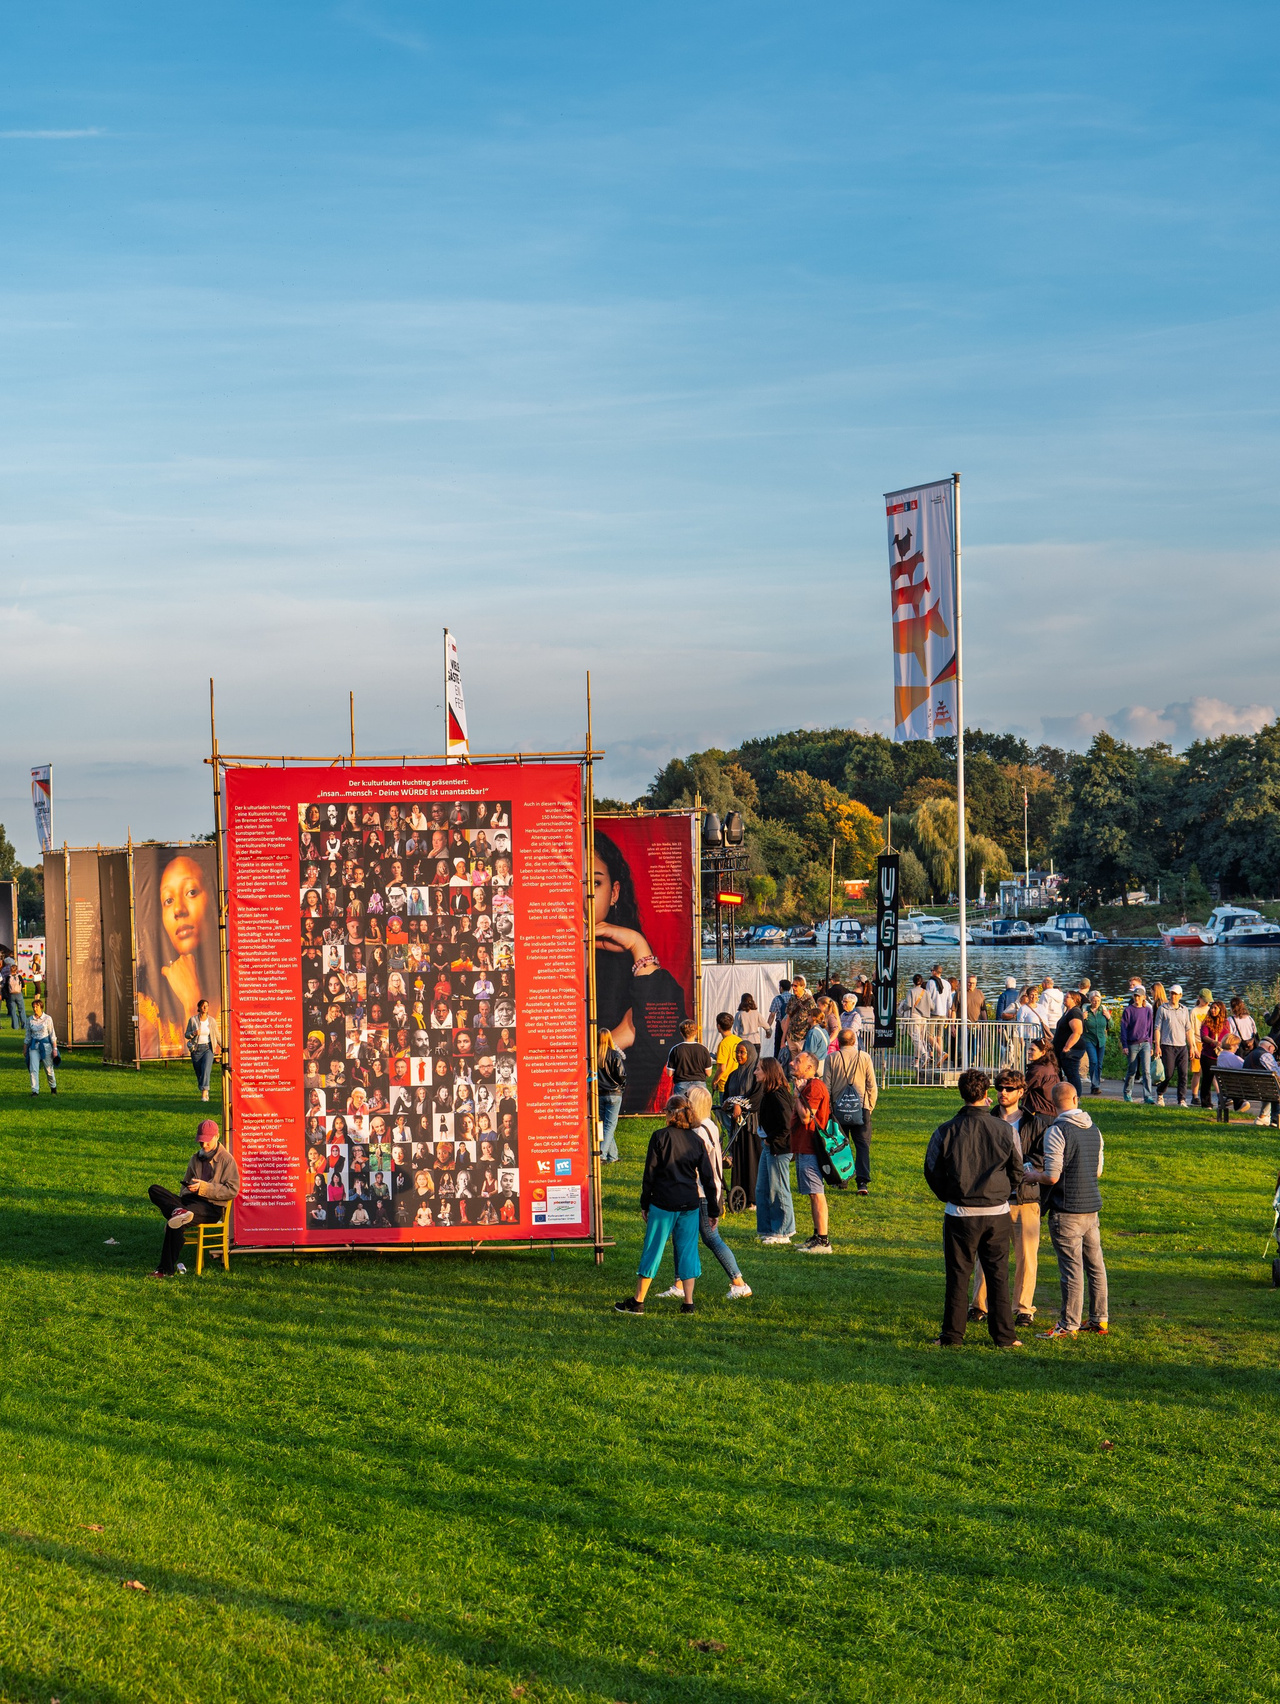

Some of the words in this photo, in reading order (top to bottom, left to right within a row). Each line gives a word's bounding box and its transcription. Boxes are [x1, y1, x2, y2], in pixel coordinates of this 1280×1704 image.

[402, 779, 430, 787] Huchting
[432, 778, 469, 786] präsentiert:
[317, 789, 373, 798] „insan...mensch
[401, 788, 428, 796] WÜRDE
[440, 787, 489, 795] unantastbar!“
